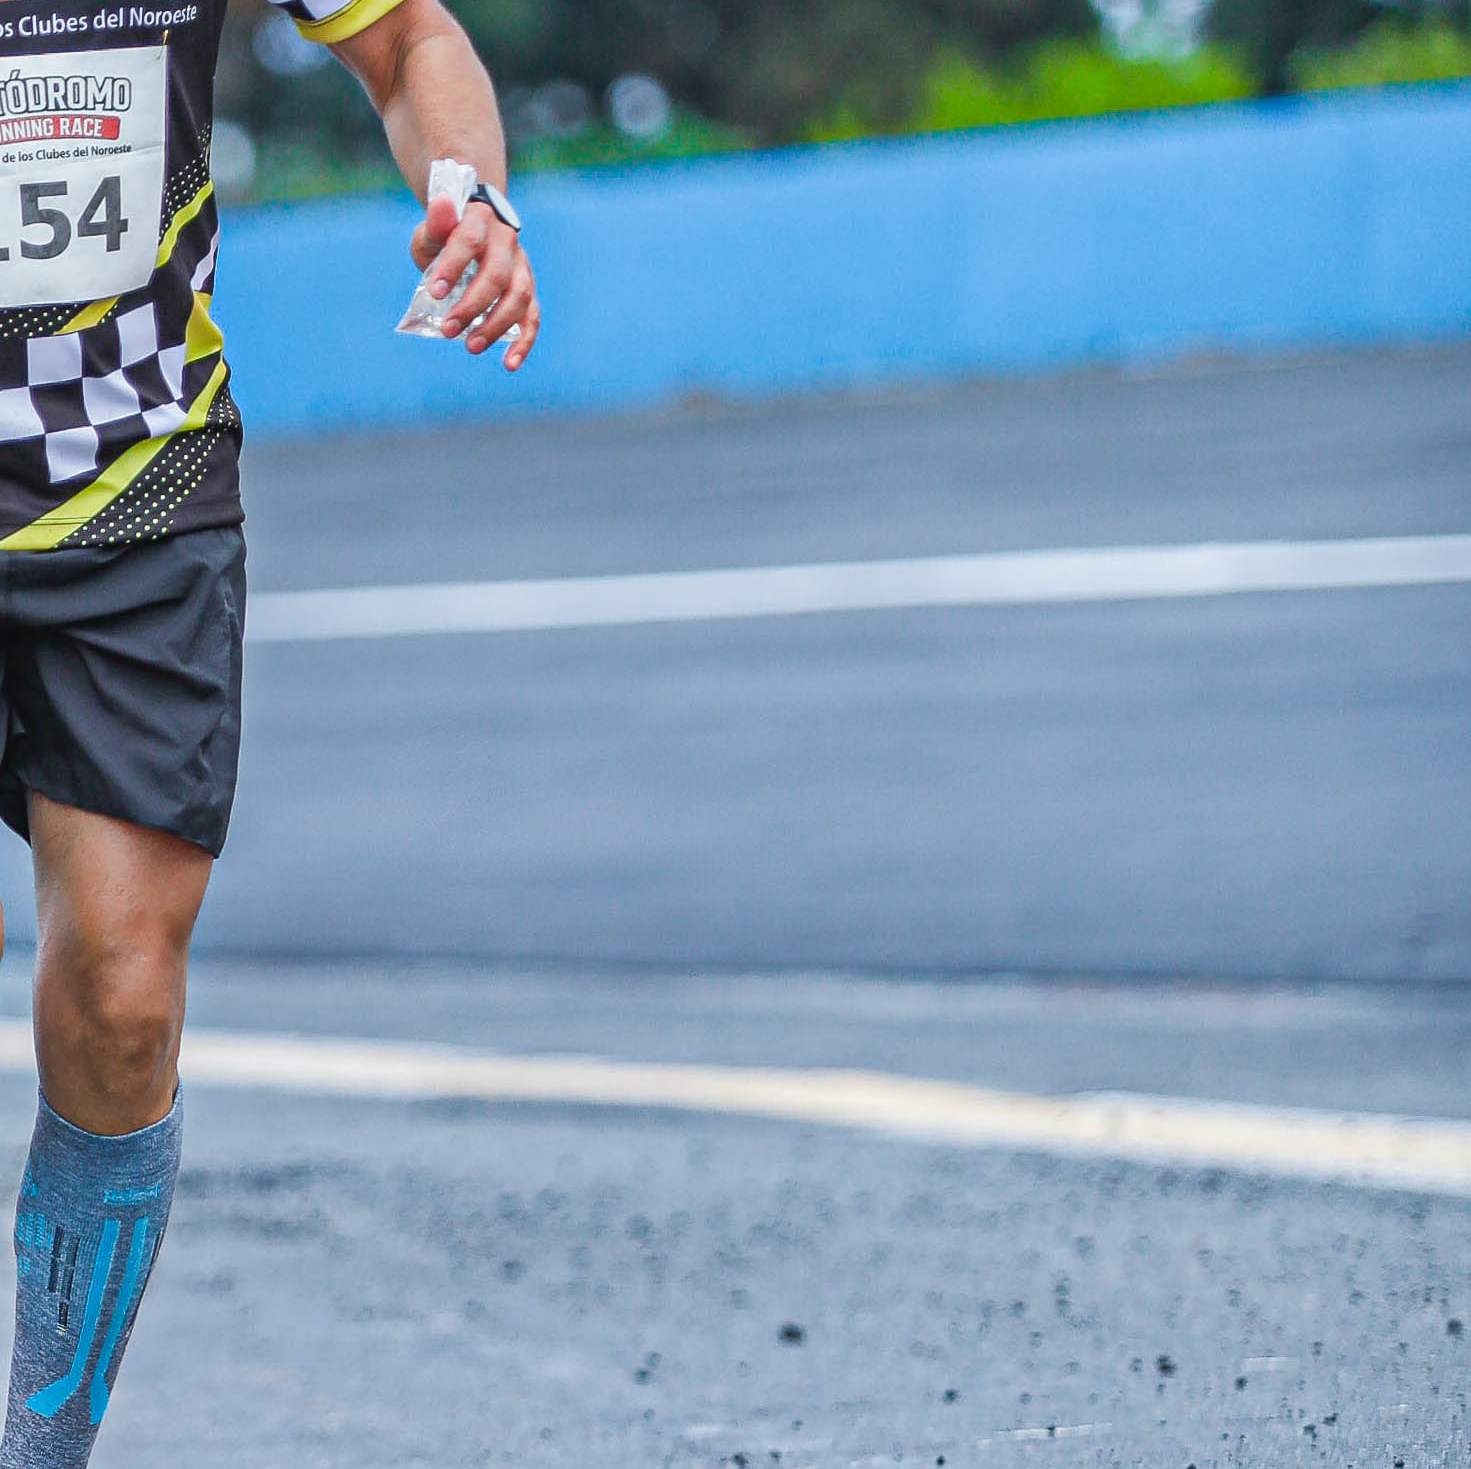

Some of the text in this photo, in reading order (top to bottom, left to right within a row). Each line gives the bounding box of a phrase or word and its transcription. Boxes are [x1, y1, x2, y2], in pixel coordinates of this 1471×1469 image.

[18, 13, 88, 36] Clubes
[92, 11, 124, 31] del
[129, 3, 198, 27] Noroeste
[59, 117, 104, 137] RACE
[2, 152, 16, 163] de
[18, 151, 33, 162] los
[36, 149, 71, 161] Clubes
[72, 146, 89, 157] del
[91, 143, 132, 156] Noroeste
